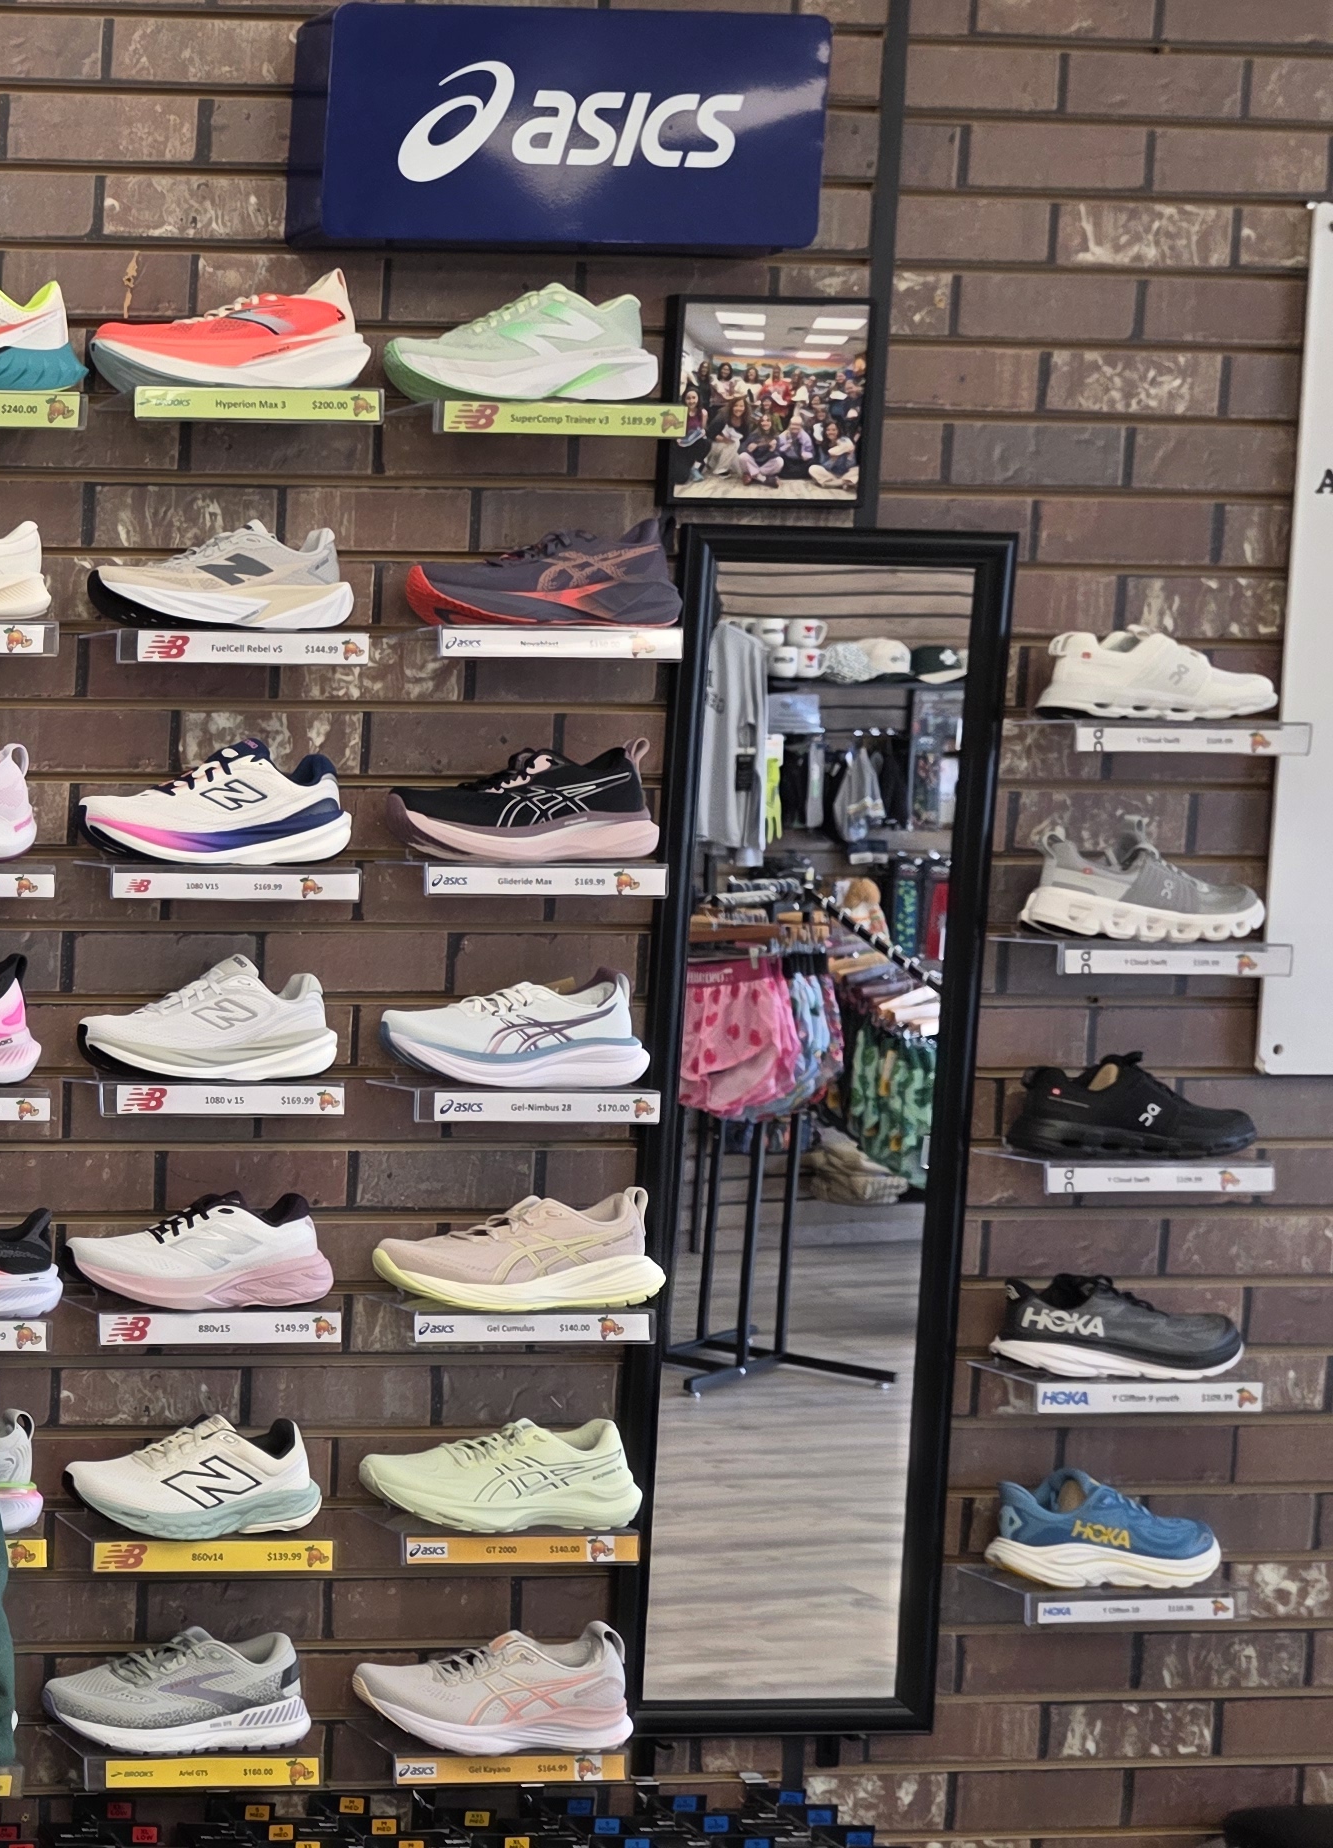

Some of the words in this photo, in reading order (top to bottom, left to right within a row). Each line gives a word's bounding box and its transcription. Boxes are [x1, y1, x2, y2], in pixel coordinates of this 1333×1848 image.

[1, 404, 37, 415] $240.00
[215, 400, 256, 411] Hyperion
[259, 400, 278, 409] Max
[281, 401, 286, 409] 3
[312, 400, 348, 411] $200.00
[510, 414, 562, 425] SuperComp
[565, 415, 596, 424] Trainer
[598, 415, 609, 425] v3
[211, 644, 245, 653] FuelCell
[247, 644, 271, 653] Rebel
[498, 877, 533, 886] Glideride
[205, 1096, 225, 1104] 1080
[235, 1096, 245, 1105] 15
[281, 1096, 314, 1106] $169.99
[511, 1103, 559, 1112] Gel-Nimbus
[561, 1104, 572, 1112] 28
[596, 1103, 630, 1113] $170.00
[1021, 1306, 1104, 1337] HOKA
[197, 1324, 231, 1333] 880v15
[274, 1323, 310, 1334] $149.99
[487, 1324, 500, 1332] Gel
[559, 1323, 590, 1333] $140.00
[1041, 1391, 1090, 1406] HOKA
[1071, 1519, 1130, 1549] HOKA
[485, 1546, 496, 1554] GT
[498, 1546, 517, 1554] 2000
[191, 1553, 223, 1562] 860v14
[267, 1552, 302, 1562] $139.99
[483, 1766, 511, 1775] Kayano
